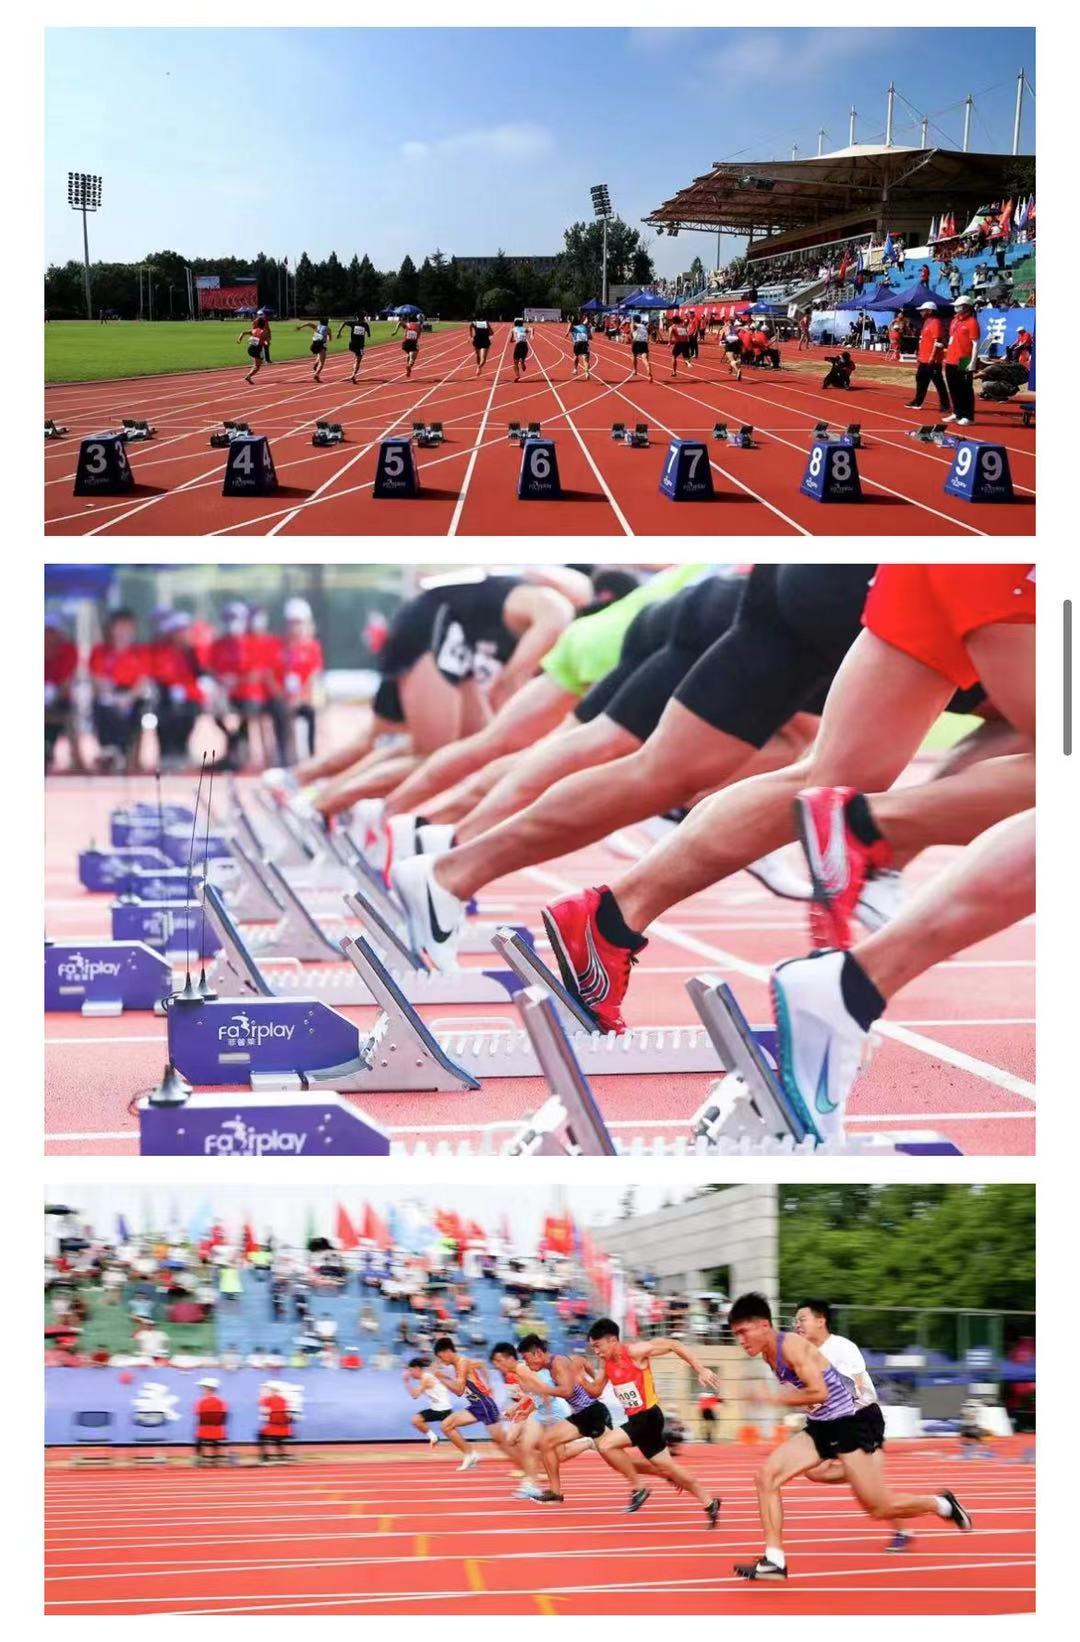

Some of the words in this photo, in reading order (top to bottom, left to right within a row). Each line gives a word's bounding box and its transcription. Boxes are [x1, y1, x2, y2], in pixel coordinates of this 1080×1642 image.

[986, 317, 1007, 345] 活
[86, 444, 108, 474] 3
[115, 441, 126, 469] 3
[232, 445, 254, 474] 4
[262, 442, 271, 469] 4
[384, 446, 404, 477] 5
[530, 448, 551, 478] 6
[667, 446, 679, 474] 7
[683, 449, 704, 479] 7
[810, 446, 823, 477] 8
[831, 450, 852, 481] 8
[955, 447, 972, 476] 9
[981, 450, 1003, 481] 9
[218, 1016, 295, 1046] fairplay
